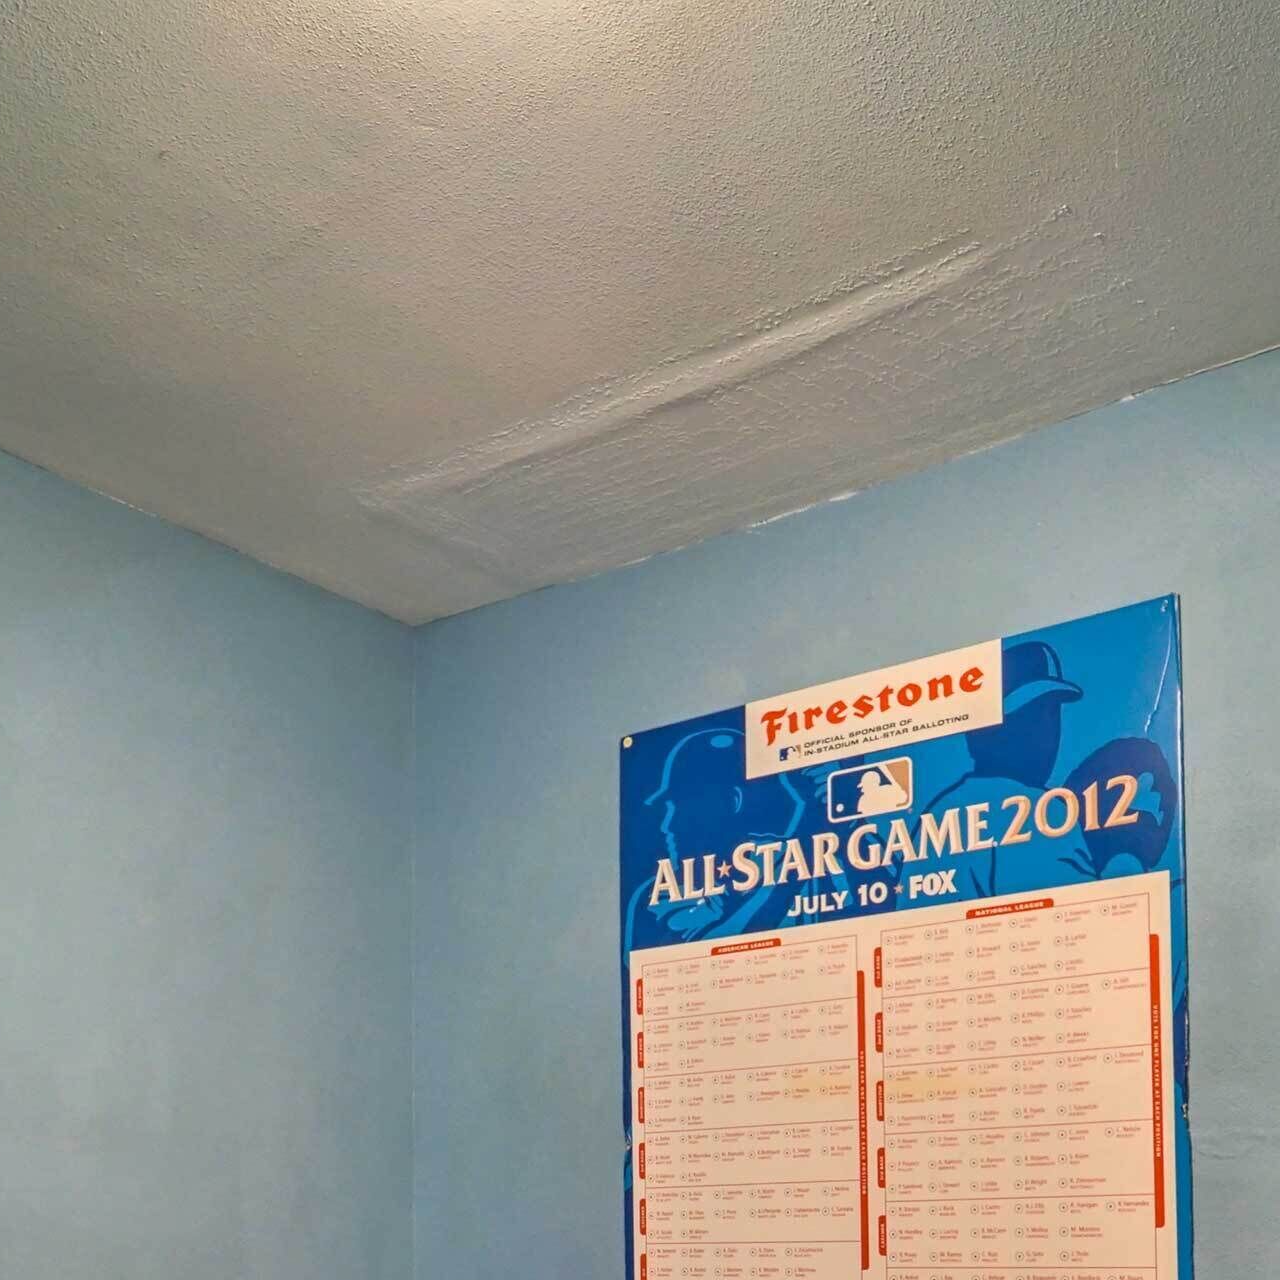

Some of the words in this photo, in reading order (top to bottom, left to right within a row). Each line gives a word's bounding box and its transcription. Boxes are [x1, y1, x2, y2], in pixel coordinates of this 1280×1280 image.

[761, 667, 985, 746] Firestone
[803, 739, 859, 757] IN-STADIUM
[862, 727, 910, 743] ALL-STAR
[912, 713, 970, 732] BALLOTING
[804, 735, 845, 748] OFFICIAL
[848, 722, 896, 739] SPONSOR
[899, 718, 913, 729] OF
[847, 801, 994, 870] GAME
[999, 774, 1140, 846] 2012
[787, 890, 849, 917] JULY
[857, 881, 888, 906] 10
[909, 869, 957, 899] FOX
